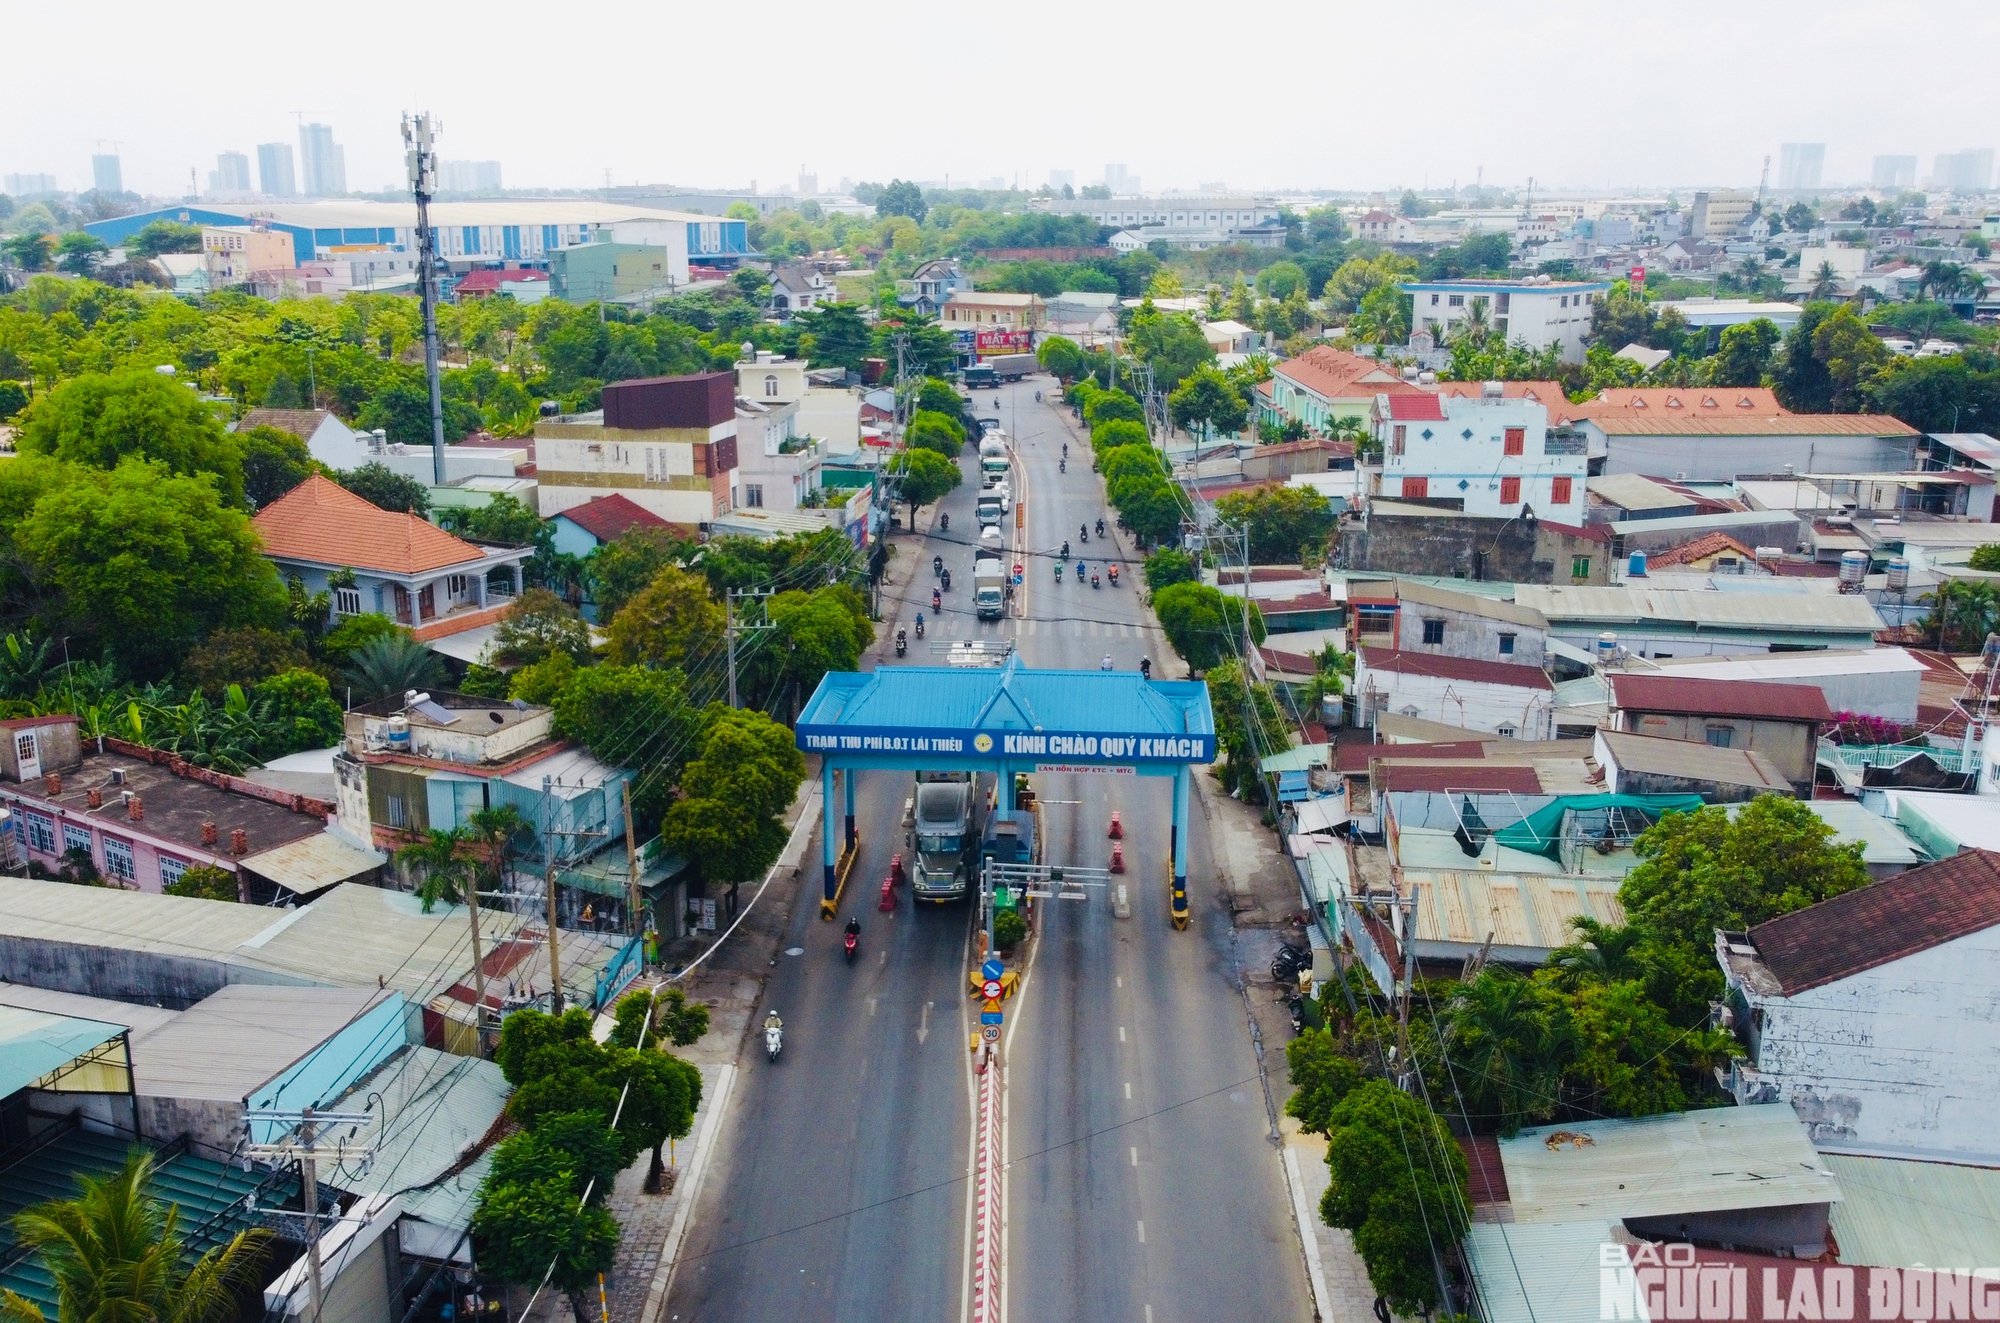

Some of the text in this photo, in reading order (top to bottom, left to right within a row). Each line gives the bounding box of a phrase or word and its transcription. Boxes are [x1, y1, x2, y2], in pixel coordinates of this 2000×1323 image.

[981, 333, 1005, 345] MẮT
[806, 735, 837, 750] TRẠM
[840, 736, 861, 749] THU
[864, 735, 883, 750] PHÍ
[884, 737, 909, 750] B.O.T
[911, 736, 929, 751] LÁI
[1004, 732, 1204, 758] KÍNH CHÀO QUÝ KHÁCH
[985, 1029, 998, 1037] 30
